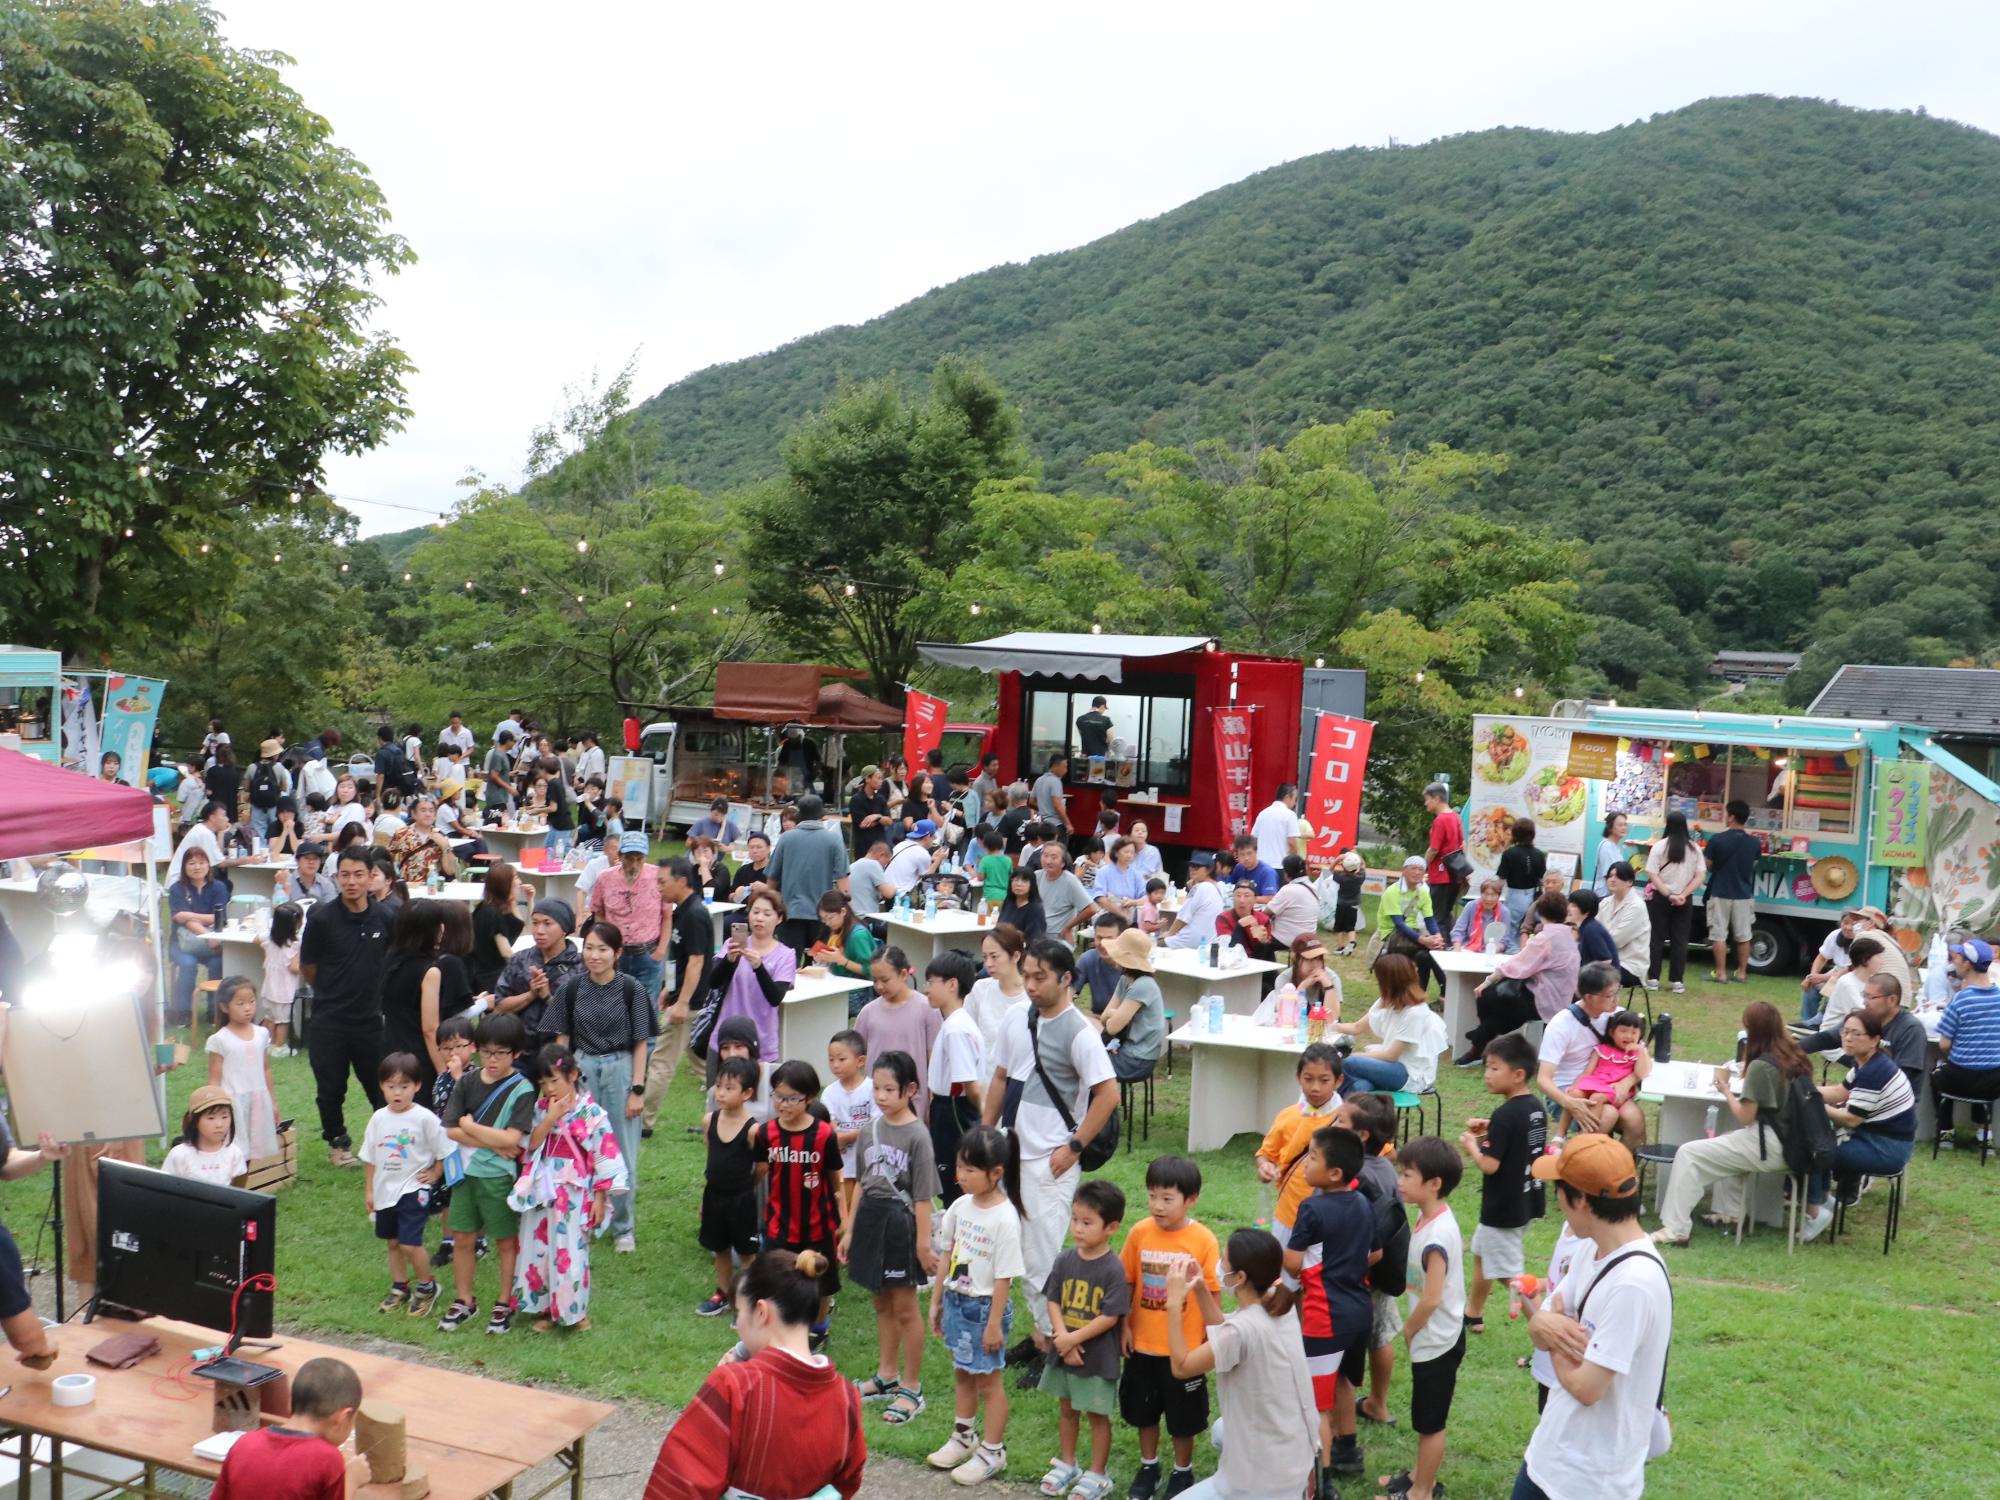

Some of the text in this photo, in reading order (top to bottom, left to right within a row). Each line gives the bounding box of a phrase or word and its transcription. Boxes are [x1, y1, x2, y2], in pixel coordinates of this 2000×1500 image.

[1578, 743, 1608, 753] FOOD
[1317, 726, 1357, 848] コロッケ
[1886, 786, 1905, 844] タコス
[1752, 872, 1791, 899] NIA
[767, 1146, 821, 1164] Milano
